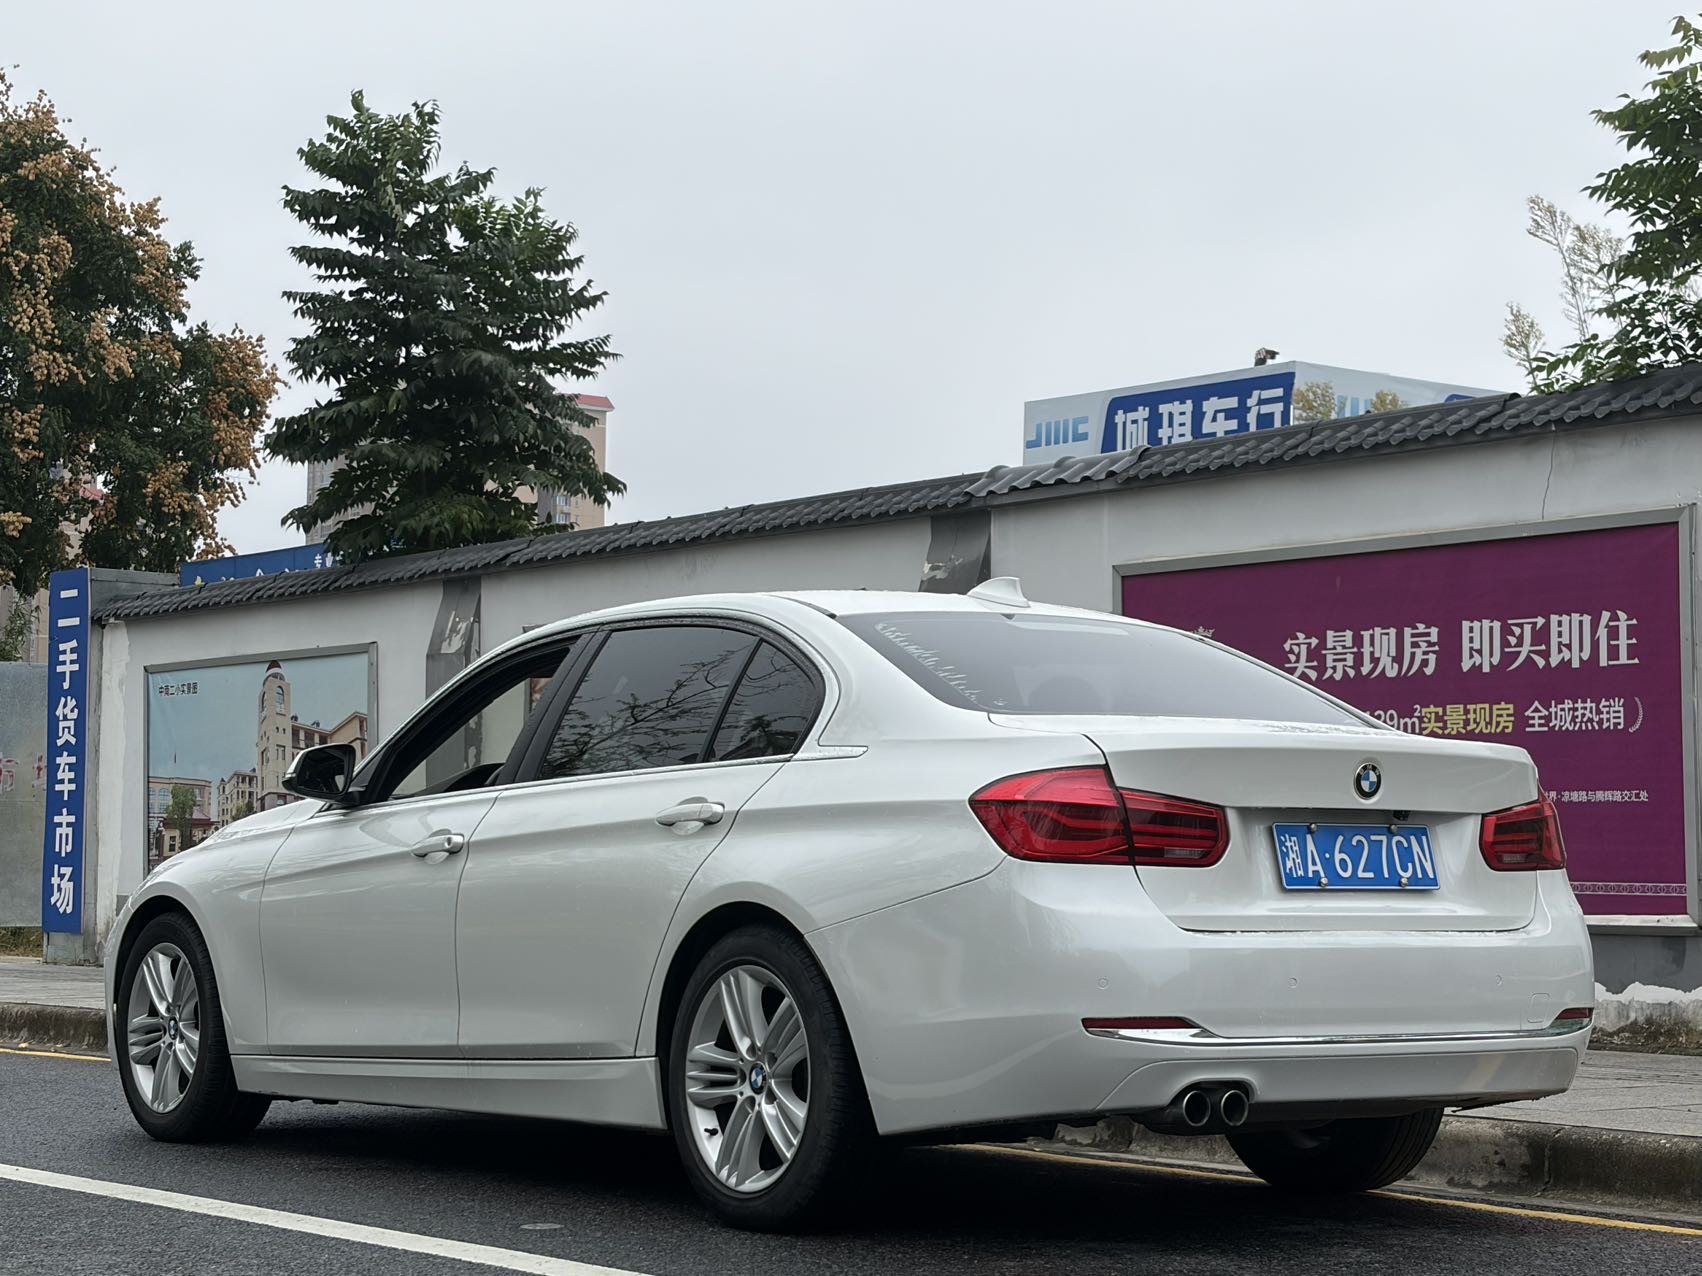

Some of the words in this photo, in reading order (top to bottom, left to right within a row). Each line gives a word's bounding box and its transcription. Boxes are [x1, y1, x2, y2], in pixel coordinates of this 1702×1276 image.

[1026, 416, 1089, 449] JMC
[1283, 623, 1440, 681] 实景现房
[1460, 610, 1640, 673] 即买即住
[1524, 698, 1625, 733] 全城热销
[50, 588, 81, 915] 二手货车市场
[1280, 833, 1435, 879] 湘A·627CN
